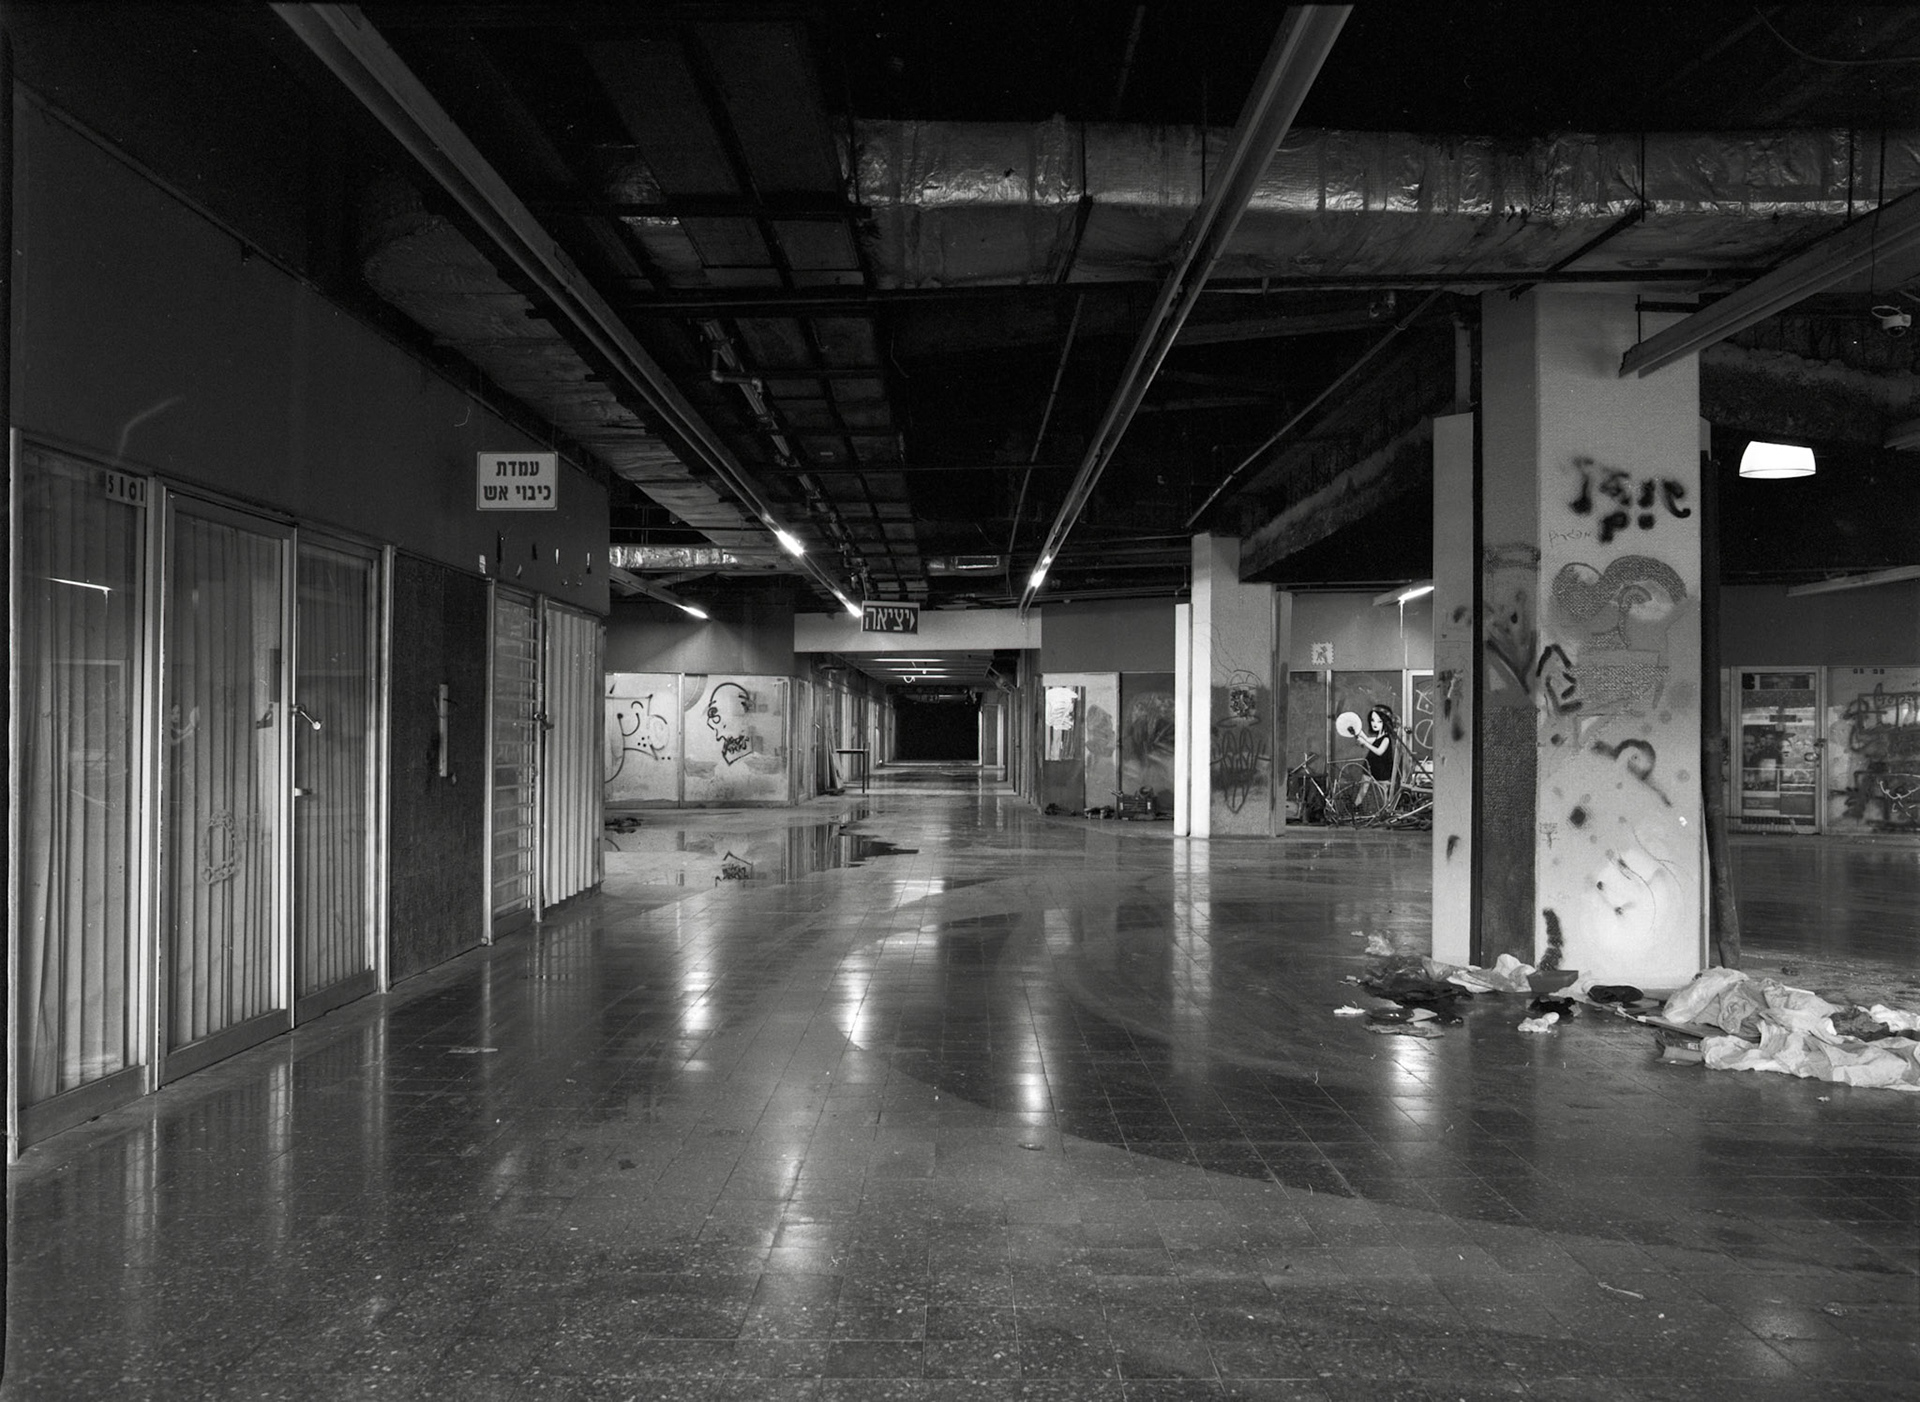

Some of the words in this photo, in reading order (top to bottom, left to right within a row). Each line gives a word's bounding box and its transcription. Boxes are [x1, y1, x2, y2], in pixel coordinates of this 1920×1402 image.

[495, 461, 540, 477] עמדת
[108, 475, 144, 502] 5101
[483, 485, 509, 501] אש
[515, 485, 552, 501] כיבוי
[865, 607, 910, 631] יציאה
